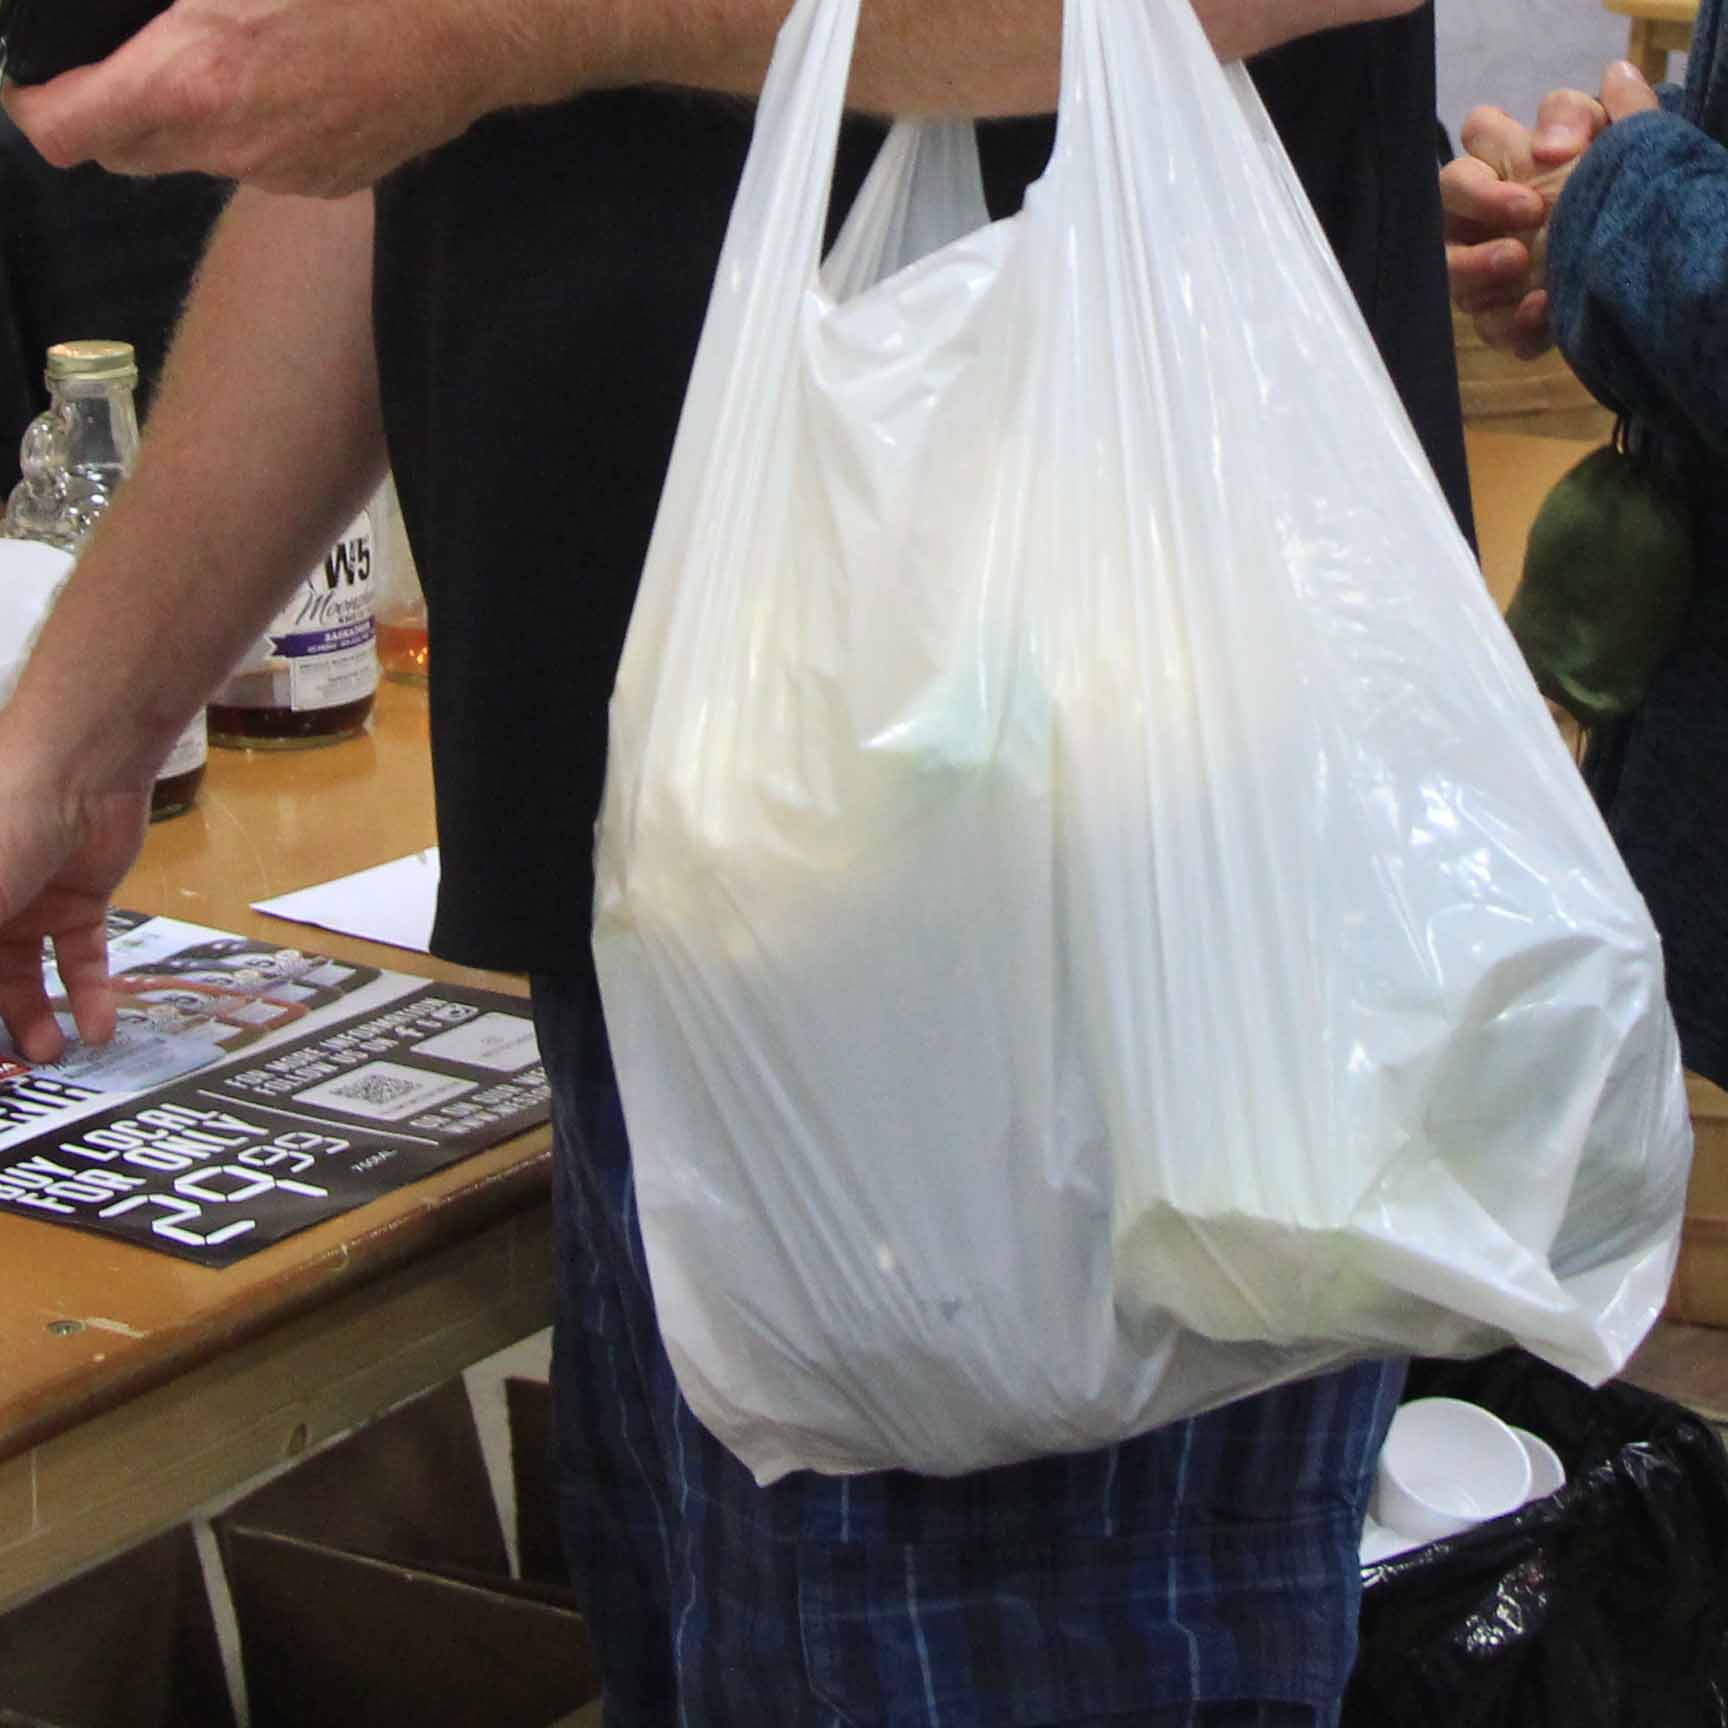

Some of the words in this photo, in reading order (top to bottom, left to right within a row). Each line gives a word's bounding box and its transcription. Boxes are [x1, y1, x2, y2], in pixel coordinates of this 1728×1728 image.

[223, 1071, 276, 1090] FOR
[264, 1046, 330, 1074] MORE
[251, 1060, 340, 1097] FOLLOW
[59, 1103, 219, 1163] LOCAL
[15, 1168, 147, 1214] FOR
[123, 1113, 270, 1172] ONLY
